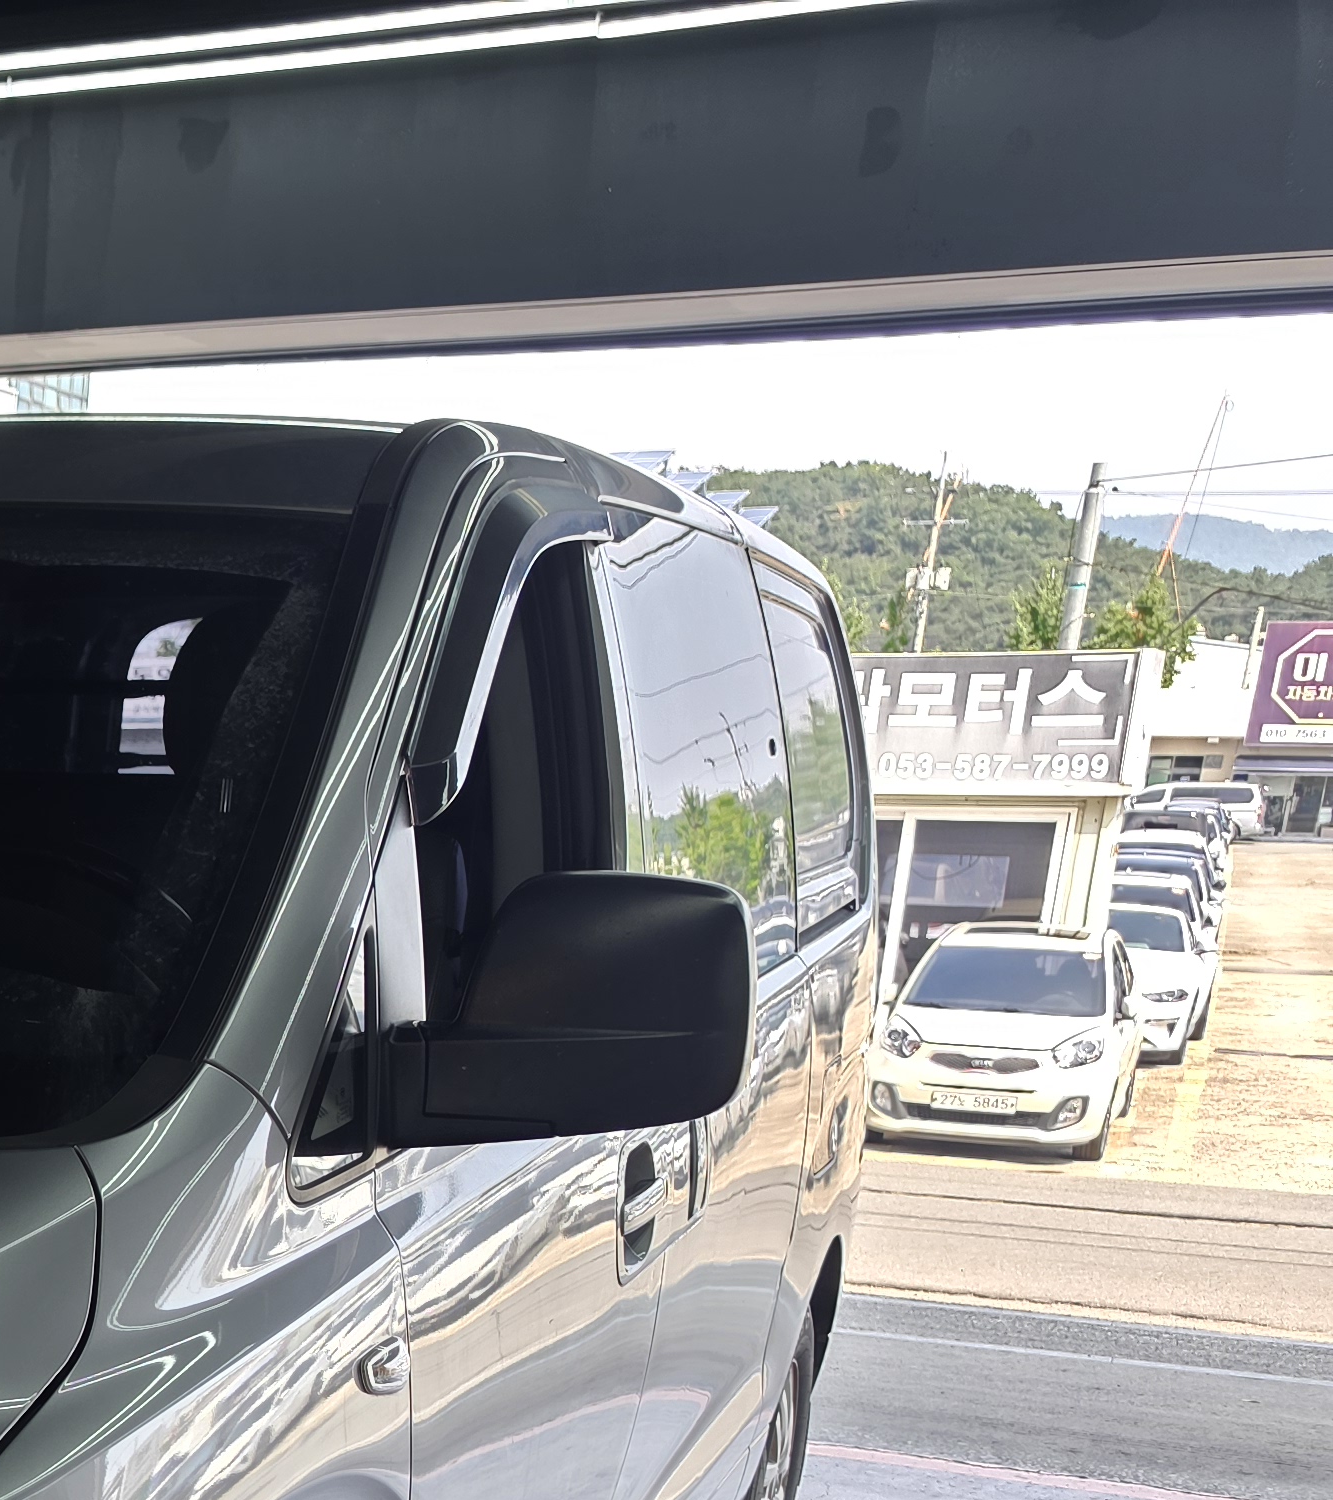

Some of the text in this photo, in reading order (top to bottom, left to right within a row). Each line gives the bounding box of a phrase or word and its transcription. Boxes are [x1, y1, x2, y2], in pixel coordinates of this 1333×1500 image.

[1265, 729, 1287, 738] 010
[878, 752, 1110, 781] 053-587-7999
[973, 1096, 1009, 1110] 5845
